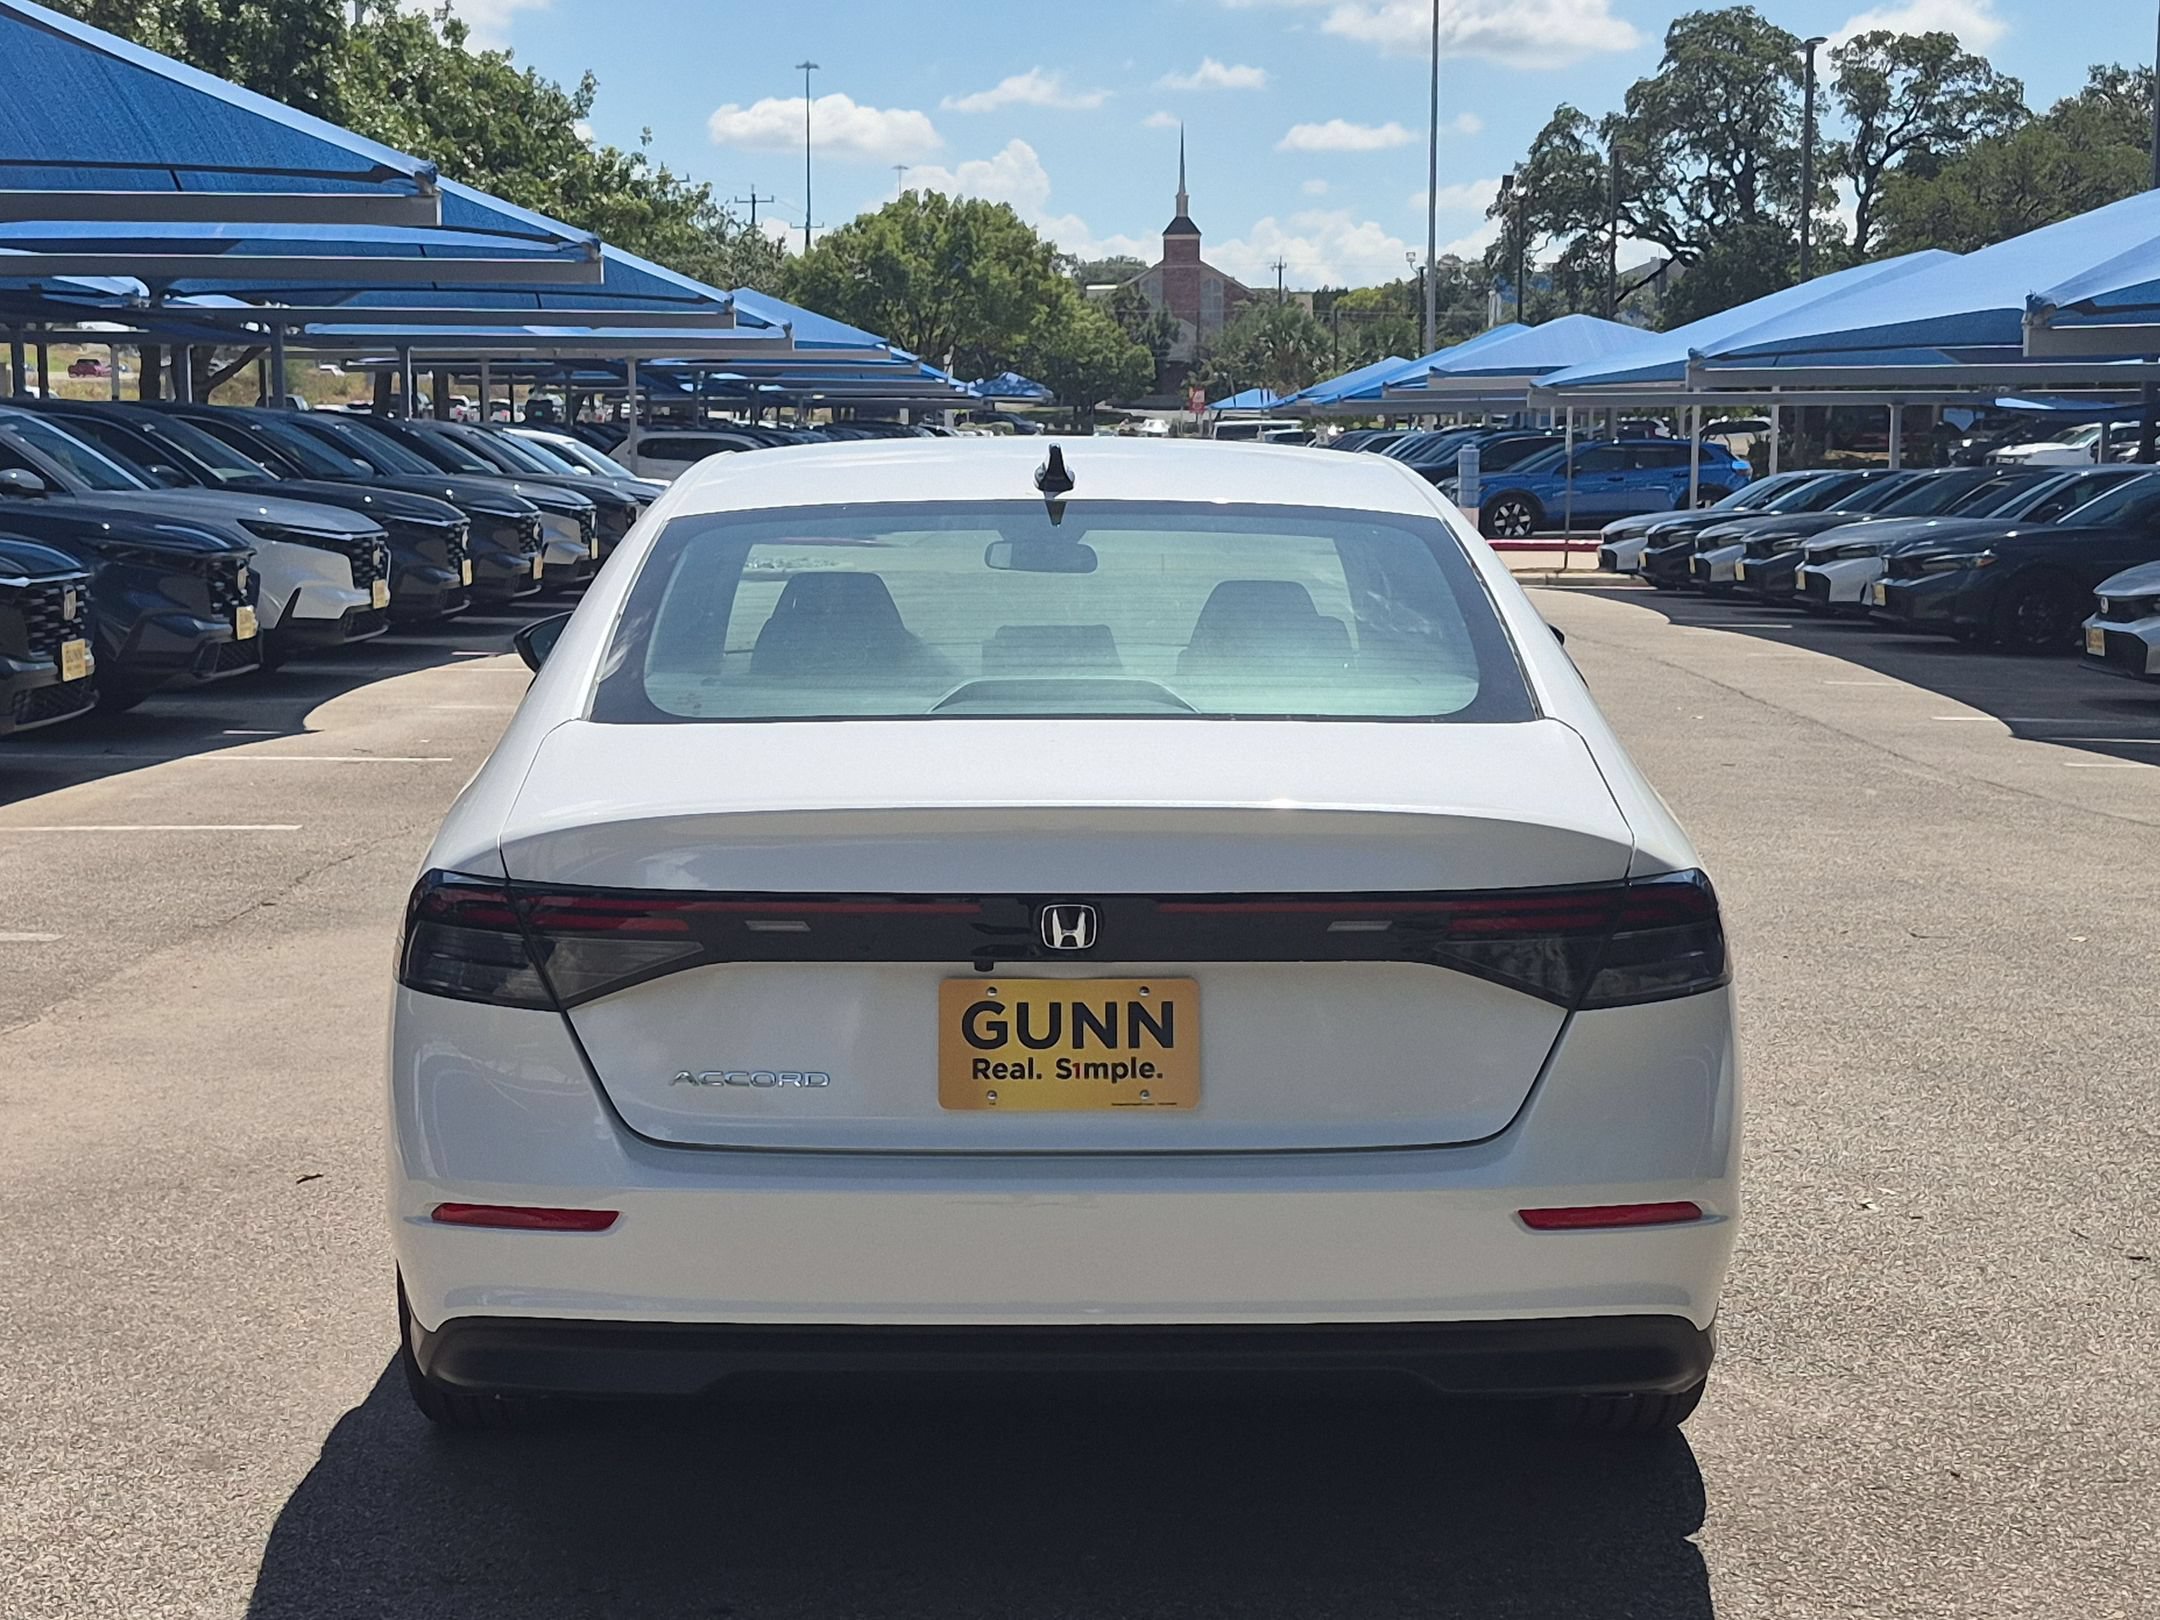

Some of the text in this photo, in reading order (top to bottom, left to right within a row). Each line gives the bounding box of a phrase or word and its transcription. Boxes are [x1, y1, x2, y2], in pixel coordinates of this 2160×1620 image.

[962, 1000, 1174, 1050] GUNN
[670, 1070, 831, 1088] ACCORD
[972, 1057, 1043, 1080] Real.
